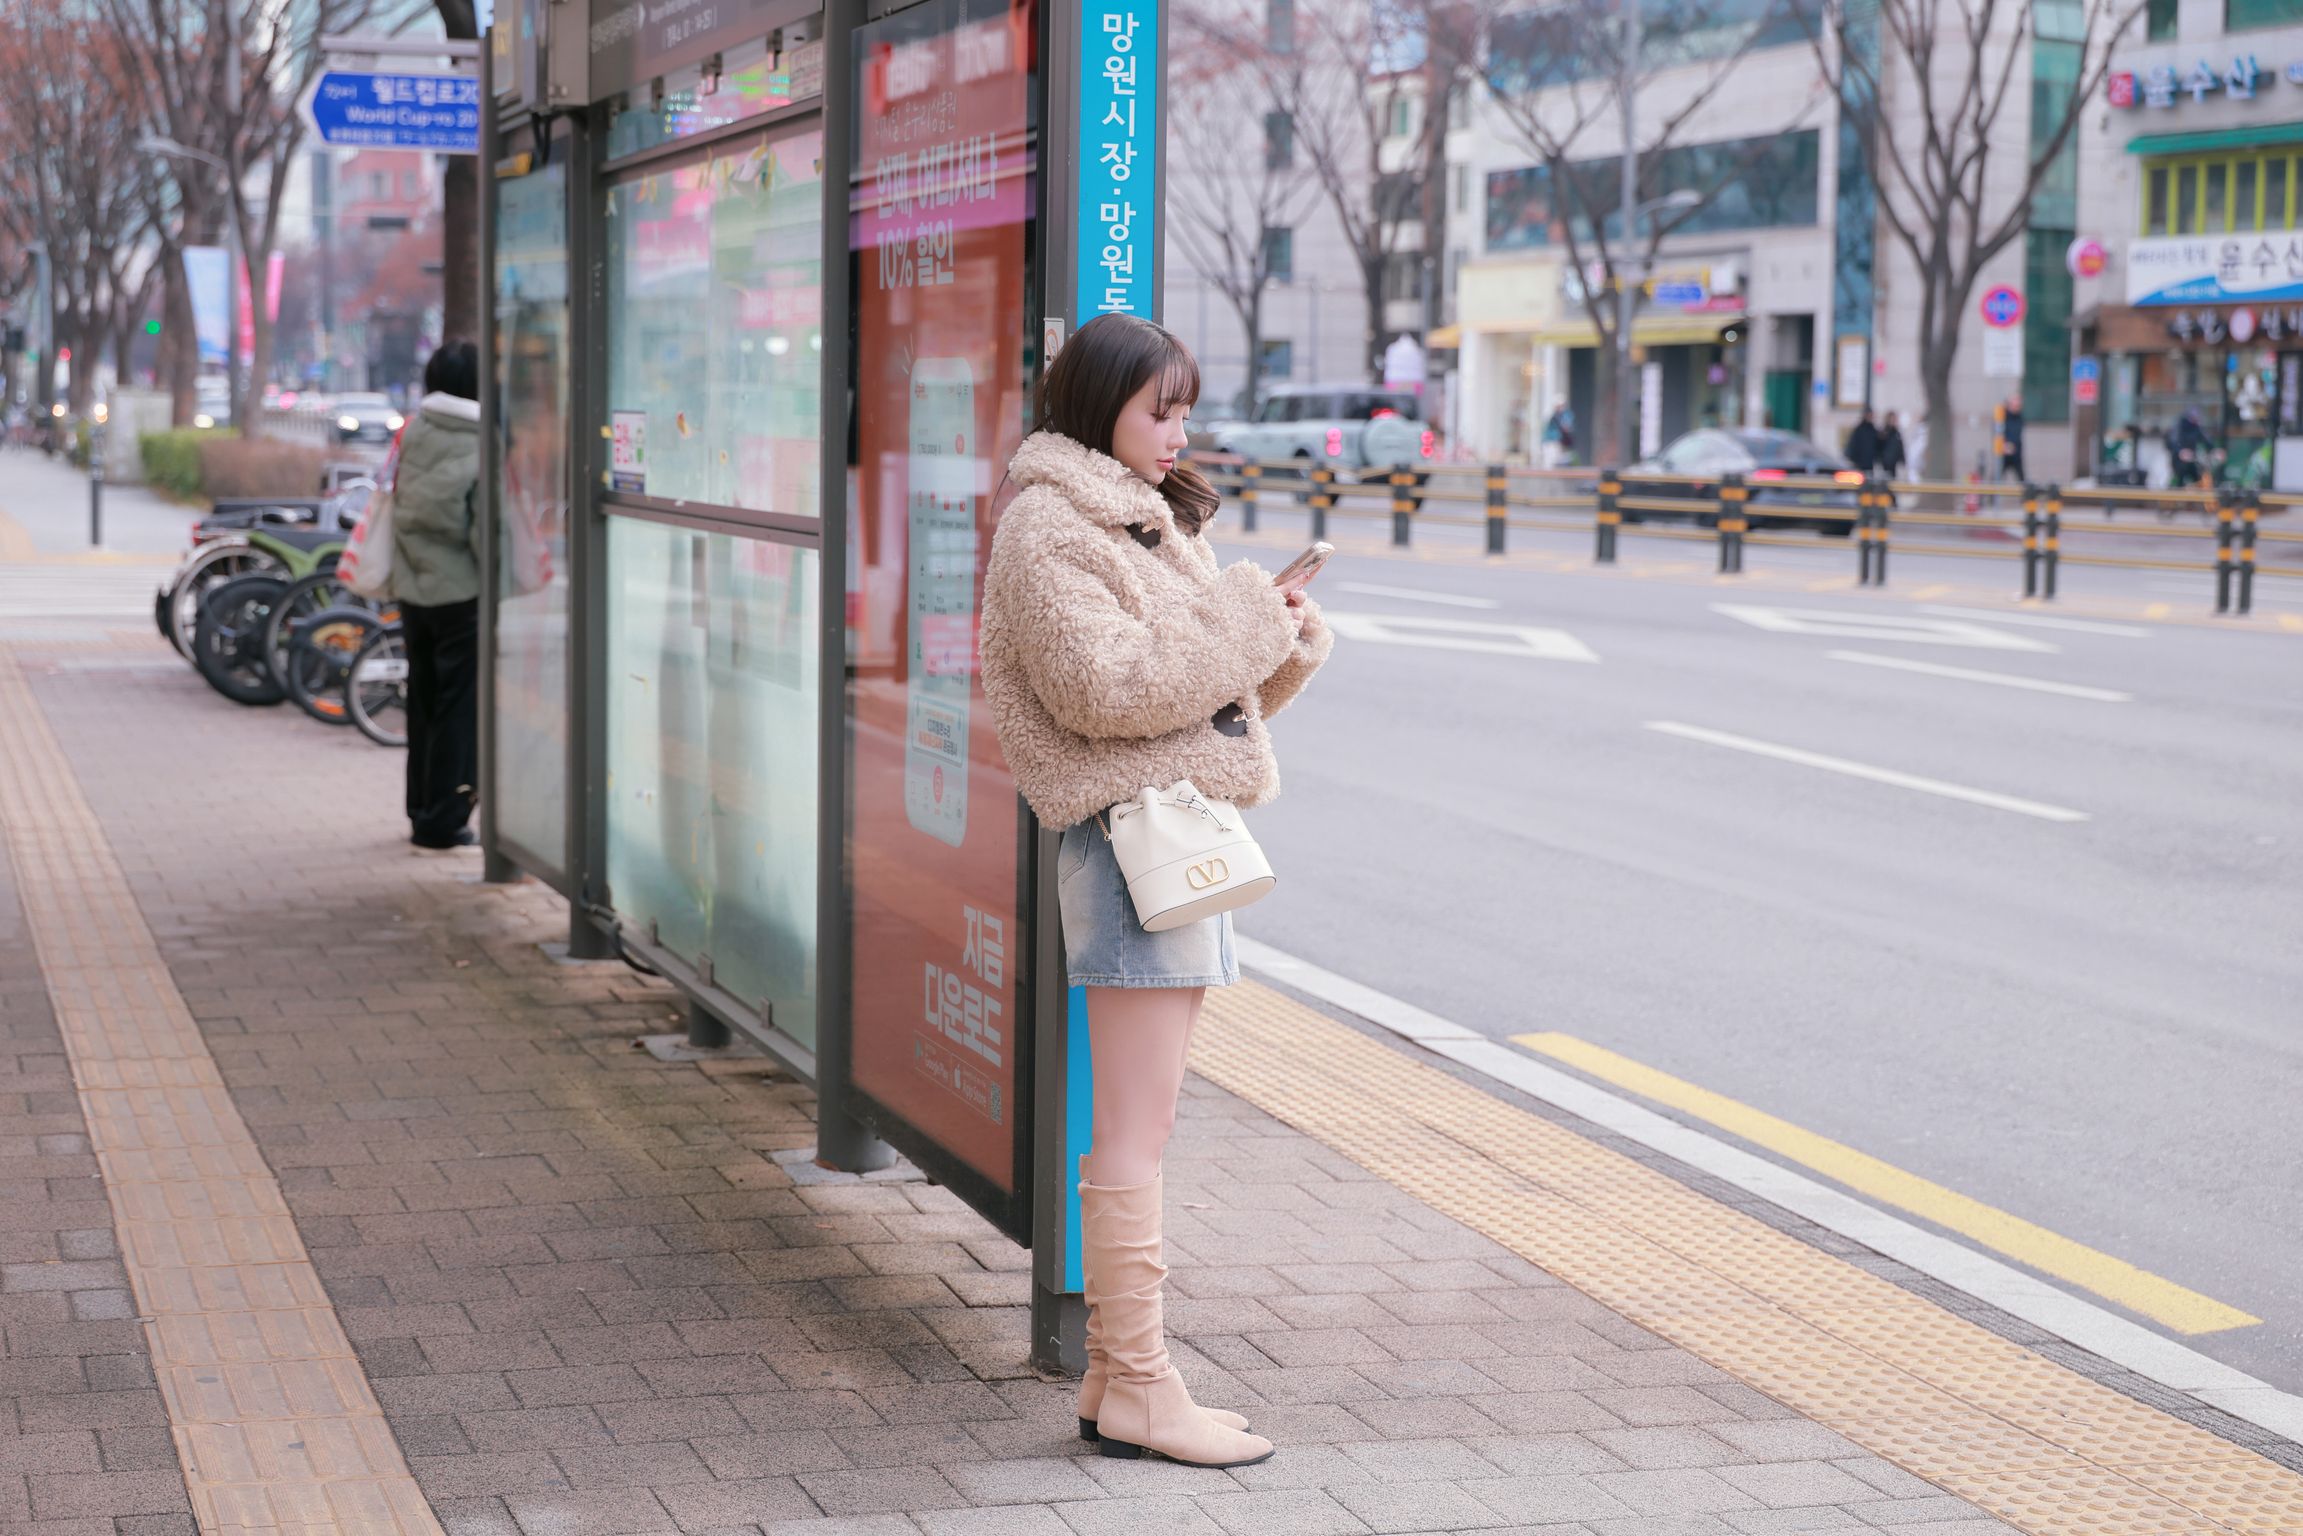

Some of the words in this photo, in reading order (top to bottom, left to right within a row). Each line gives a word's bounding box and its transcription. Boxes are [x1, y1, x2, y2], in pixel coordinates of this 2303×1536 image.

[876, 226, 914, 290] 10%
[916, 217, 955, 287] 할인
[962, 904, 1003, 989] 지금
[924, 961, 1002, 1068] 다운로드
